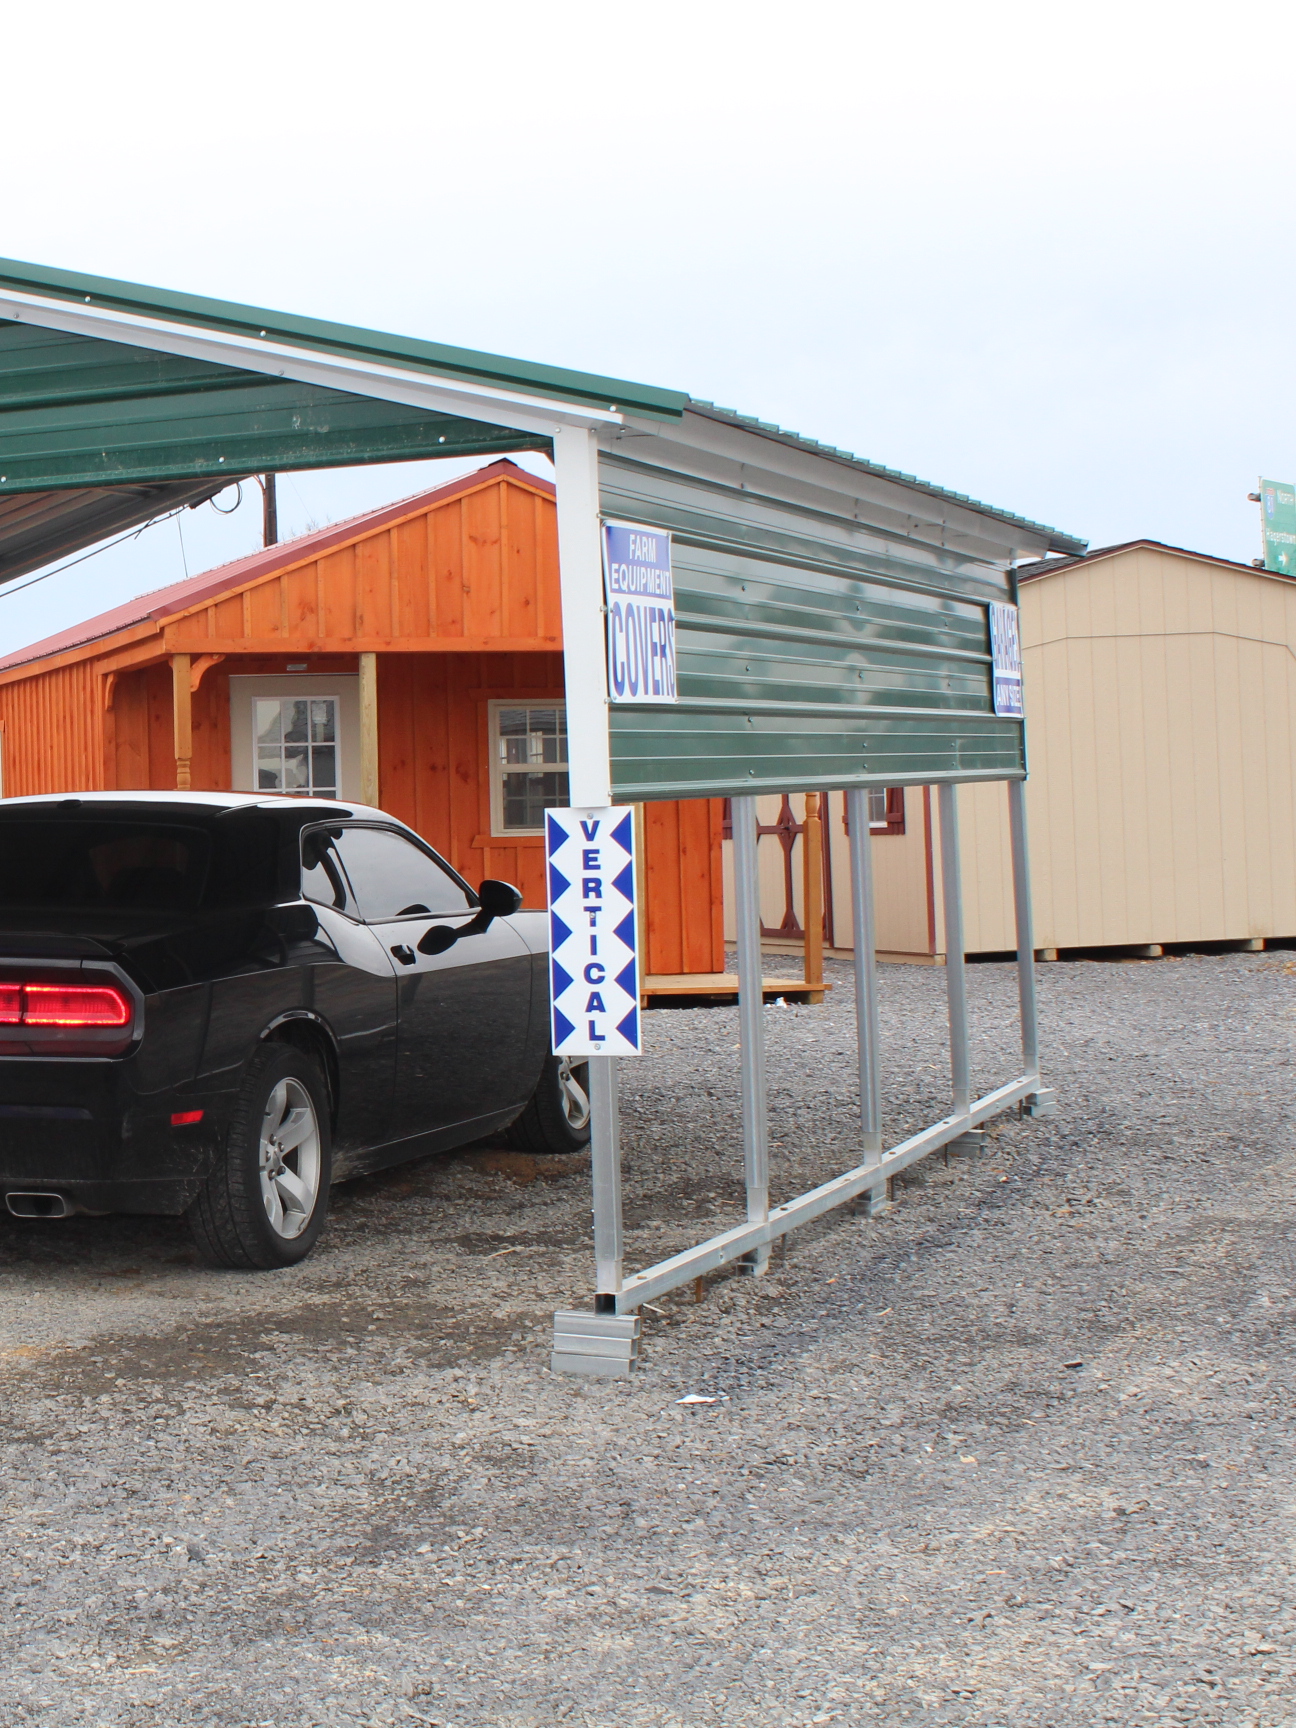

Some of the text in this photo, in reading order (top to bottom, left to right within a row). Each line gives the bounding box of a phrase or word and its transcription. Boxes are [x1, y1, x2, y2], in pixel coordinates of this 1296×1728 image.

[611, 562, 670, 596] EQUIPMENT
[629, 533, 657, 563] FARM
[612, 600, 675, 698] COVERS
[578, 820, 606, 1042] VERTICAL
